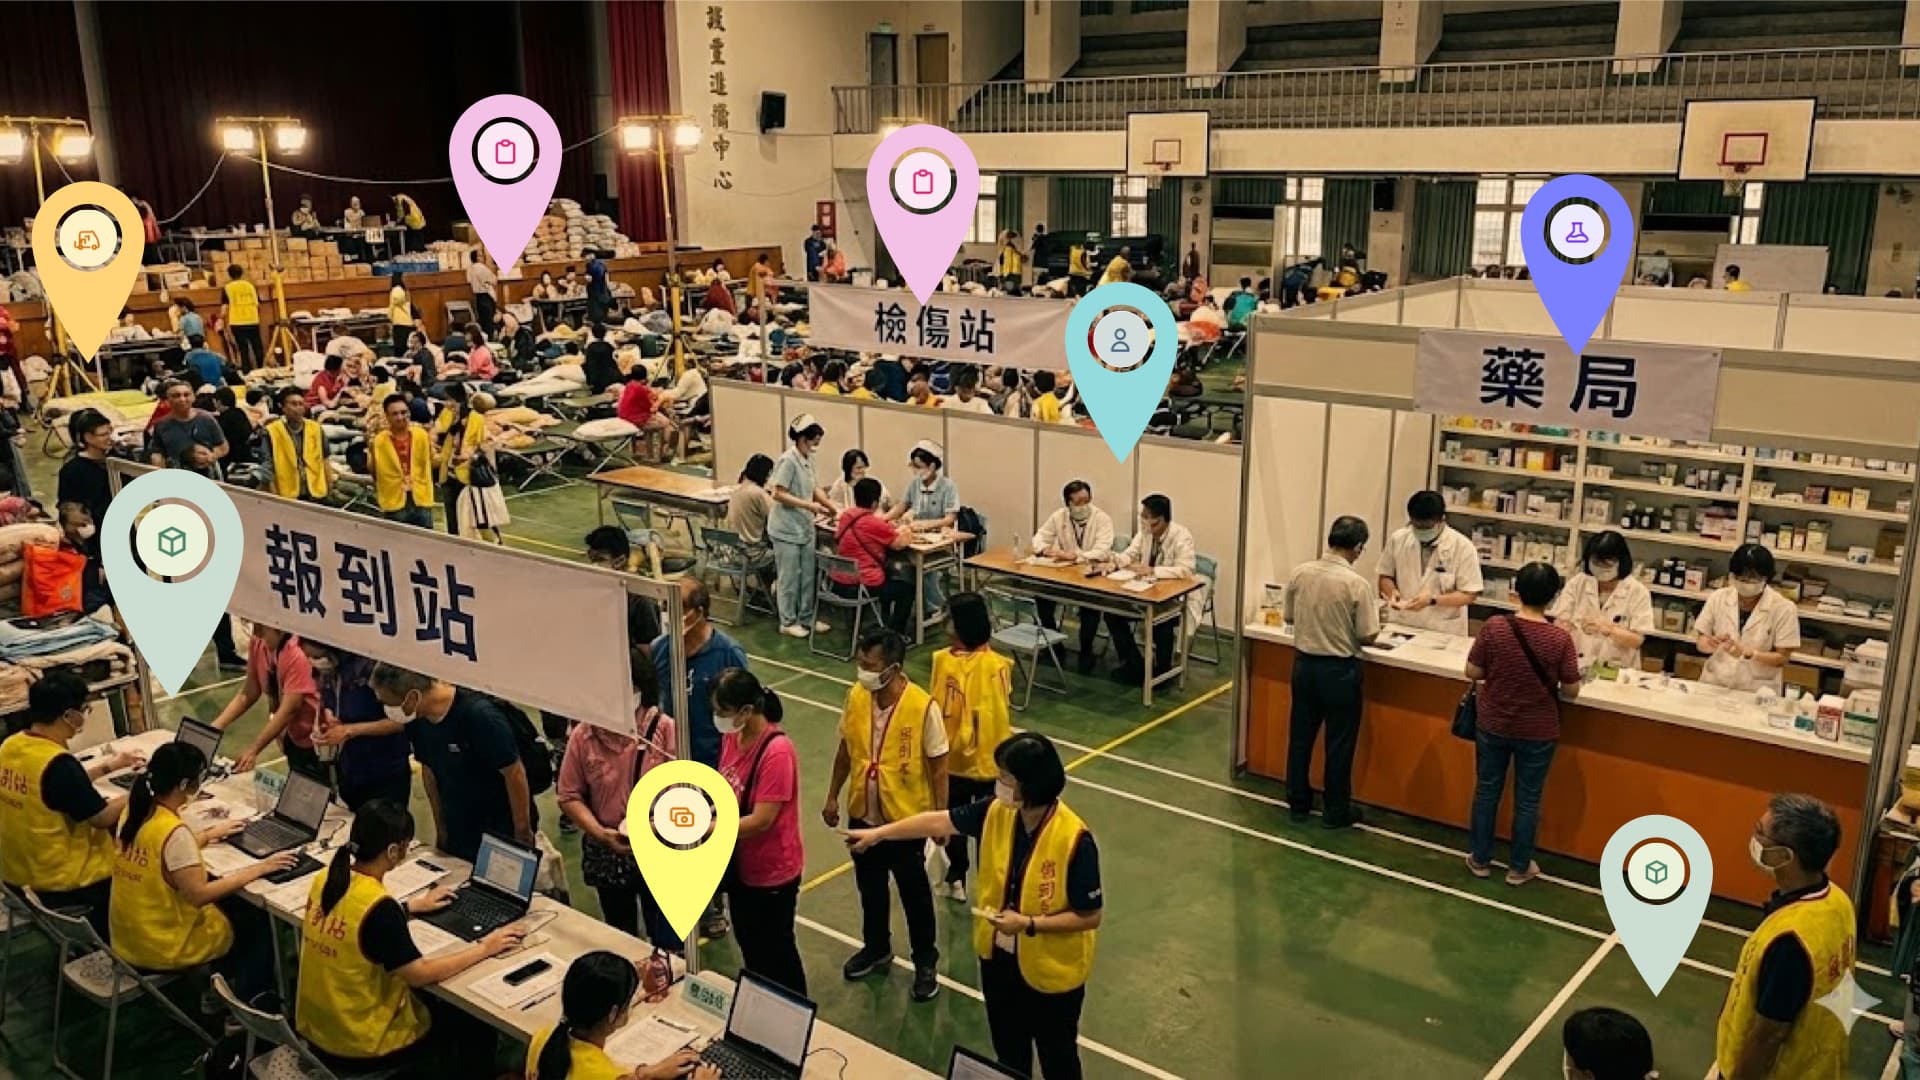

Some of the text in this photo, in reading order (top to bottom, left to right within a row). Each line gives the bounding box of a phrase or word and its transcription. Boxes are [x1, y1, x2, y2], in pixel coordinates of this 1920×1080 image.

[875, 302, 995, 353] 檢傷站
[1480, 346, 1637, 418] 藥局
[265, 523, 478, 662] 報到站
